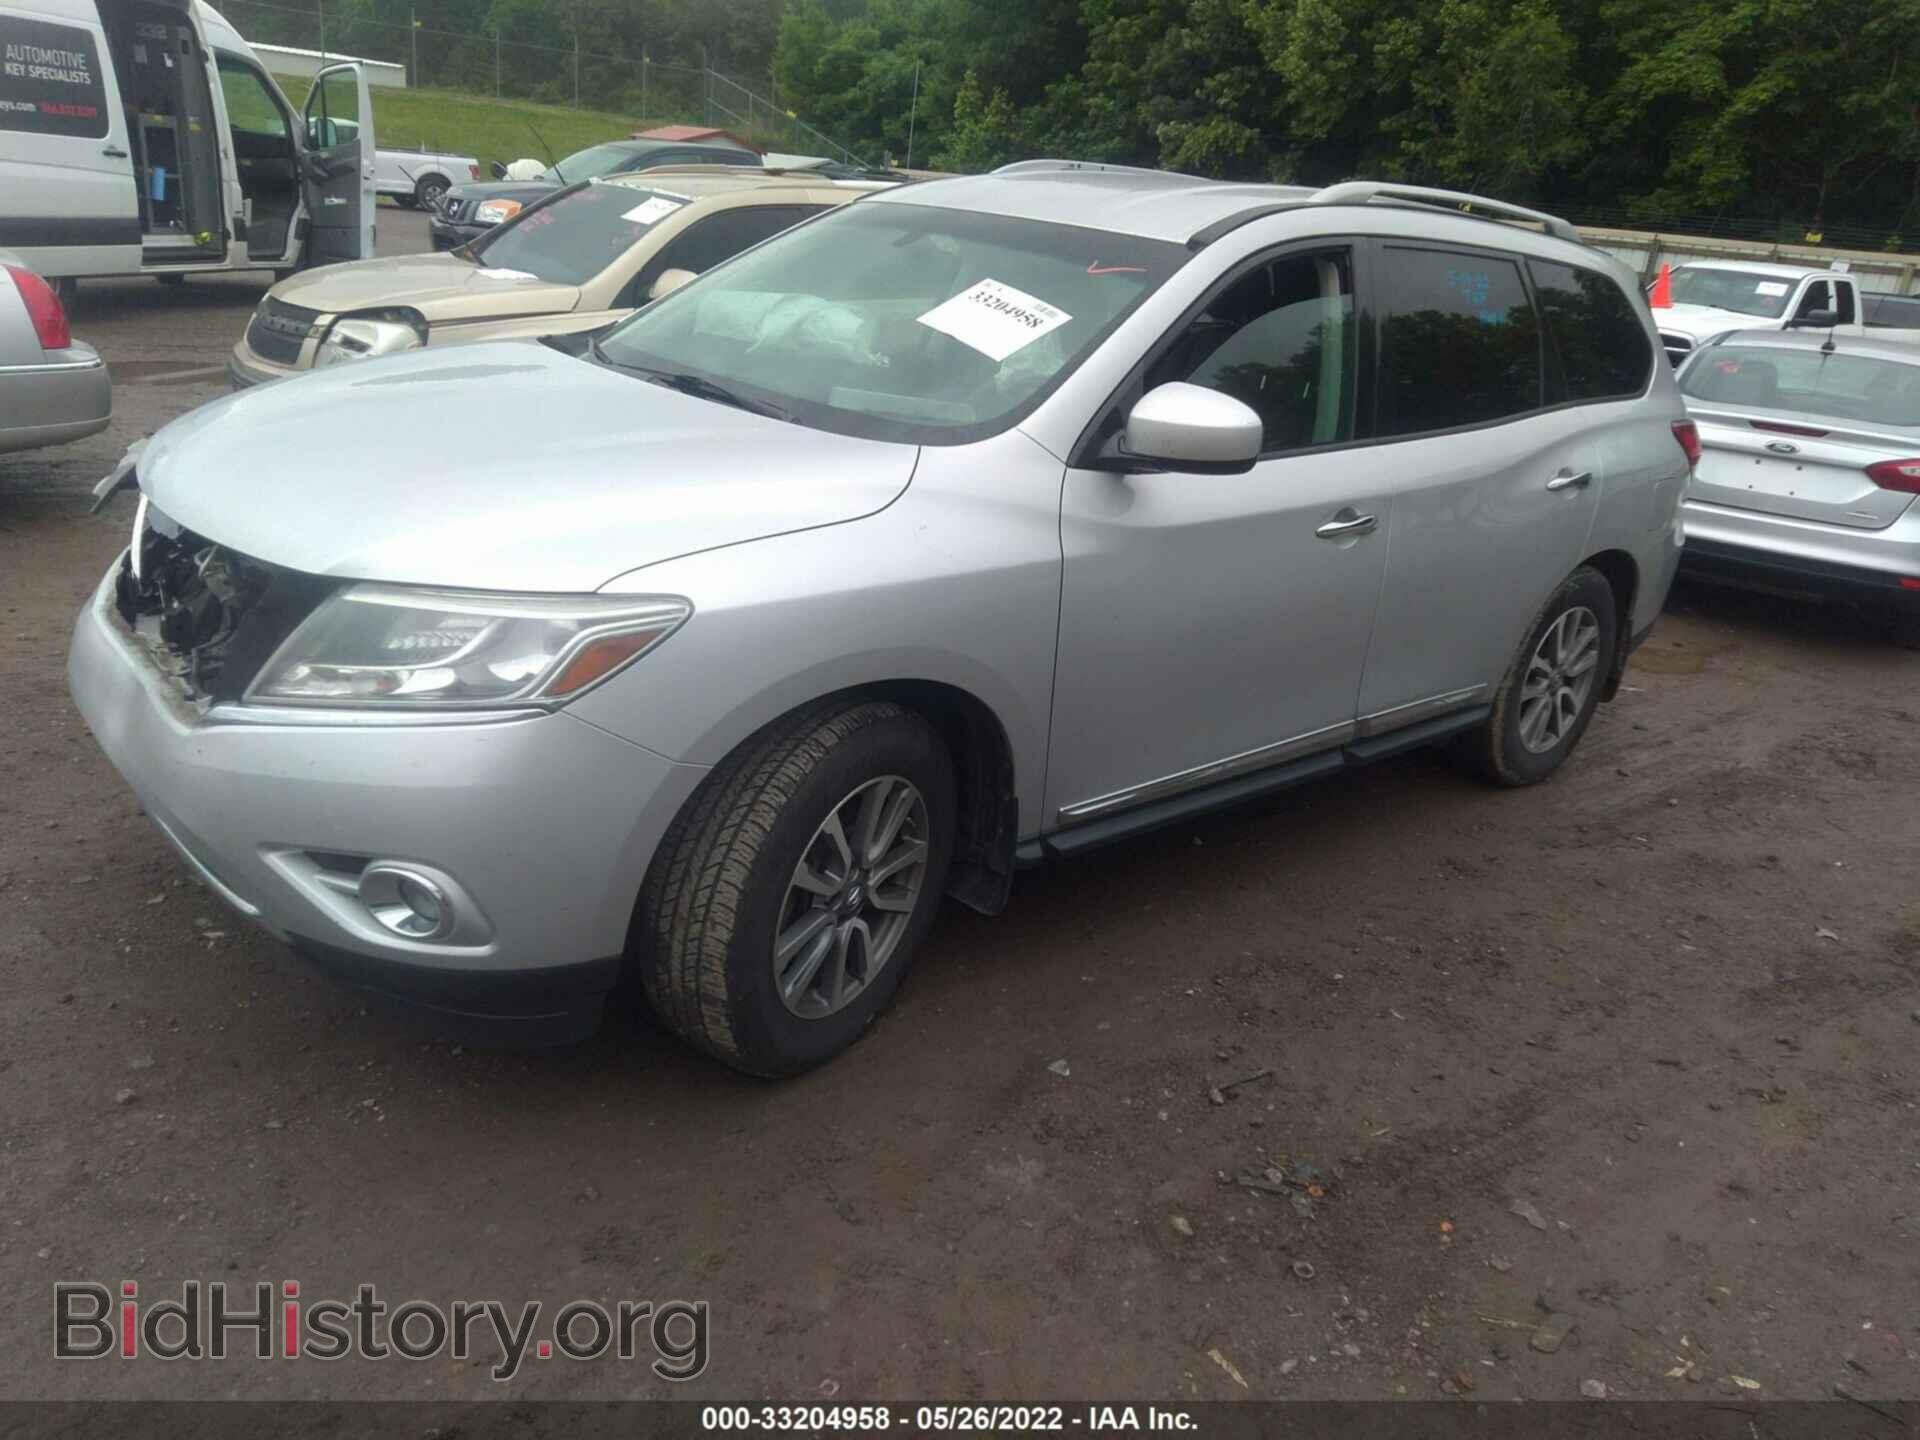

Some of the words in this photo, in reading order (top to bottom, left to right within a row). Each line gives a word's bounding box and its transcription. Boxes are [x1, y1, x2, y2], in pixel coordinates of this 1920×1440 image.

[6, 44, 87, 70] AUTOMOTIVE
[5, 62, 26, 76] KEY
[28, 65, 91, 84] SPECIALISTS
[968, 290, 1044, 328] 33204958
